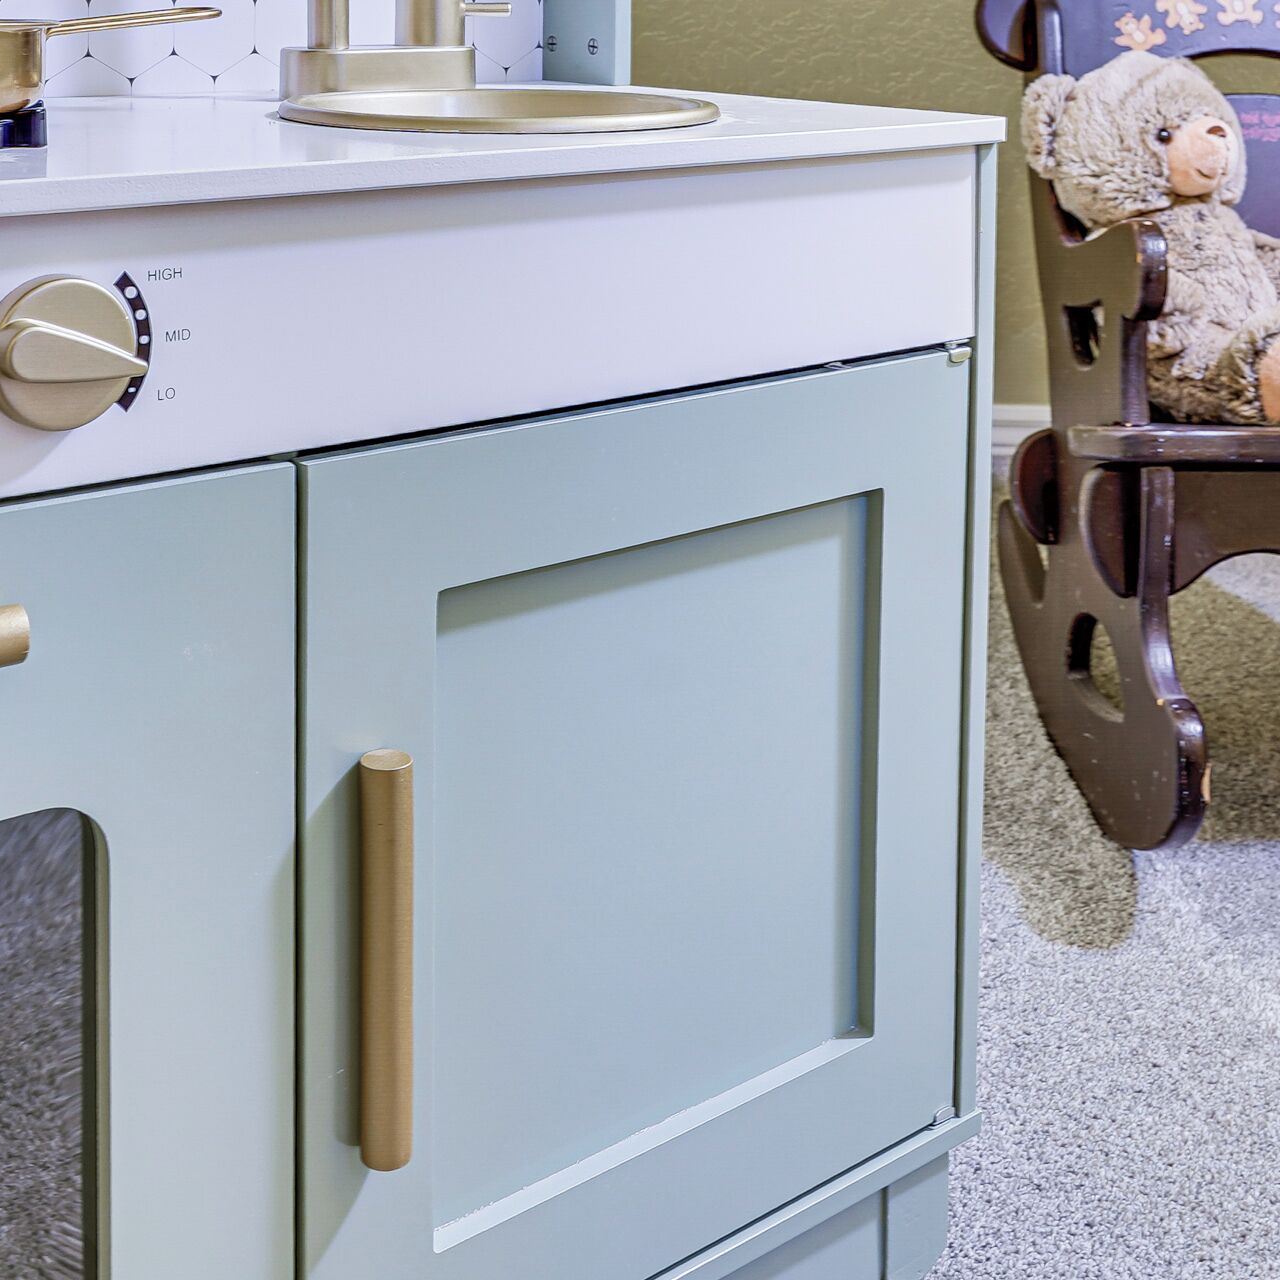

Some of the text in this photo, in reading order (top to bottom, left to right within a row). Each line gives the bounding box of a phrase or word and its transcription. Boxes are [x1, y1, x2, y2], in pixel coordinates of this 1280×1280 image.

[147, 268, 183, 281] HIGH
[165, 329, 191, 342] MID
[158, 387, 176, 401] LO
